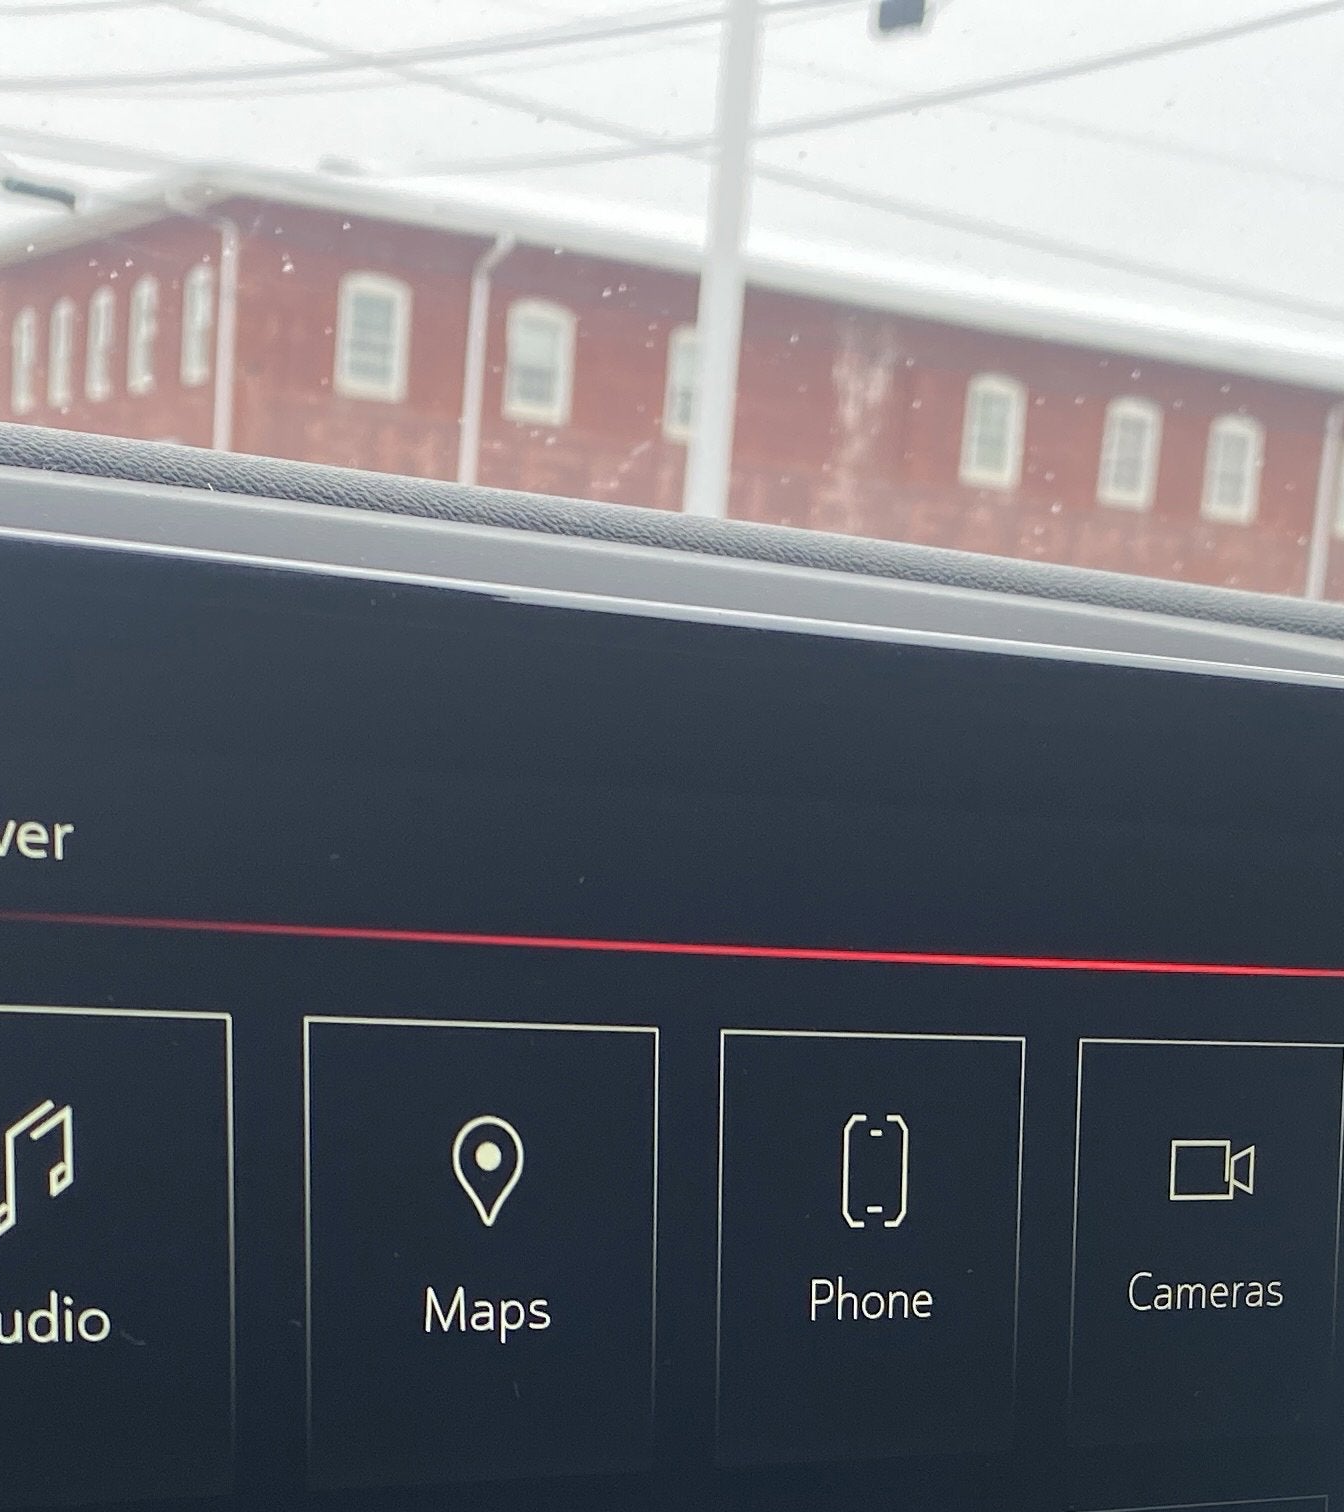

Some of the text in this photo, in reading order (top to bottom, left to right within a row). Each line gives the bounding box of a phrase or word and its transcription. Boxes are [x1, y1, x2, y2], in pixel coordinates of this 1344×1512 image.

[809, 1276, 934, 1321] Phone
[1127, 1271, 1285, 1312] Cameras
[424, 1286, 552, 1344] Maps
